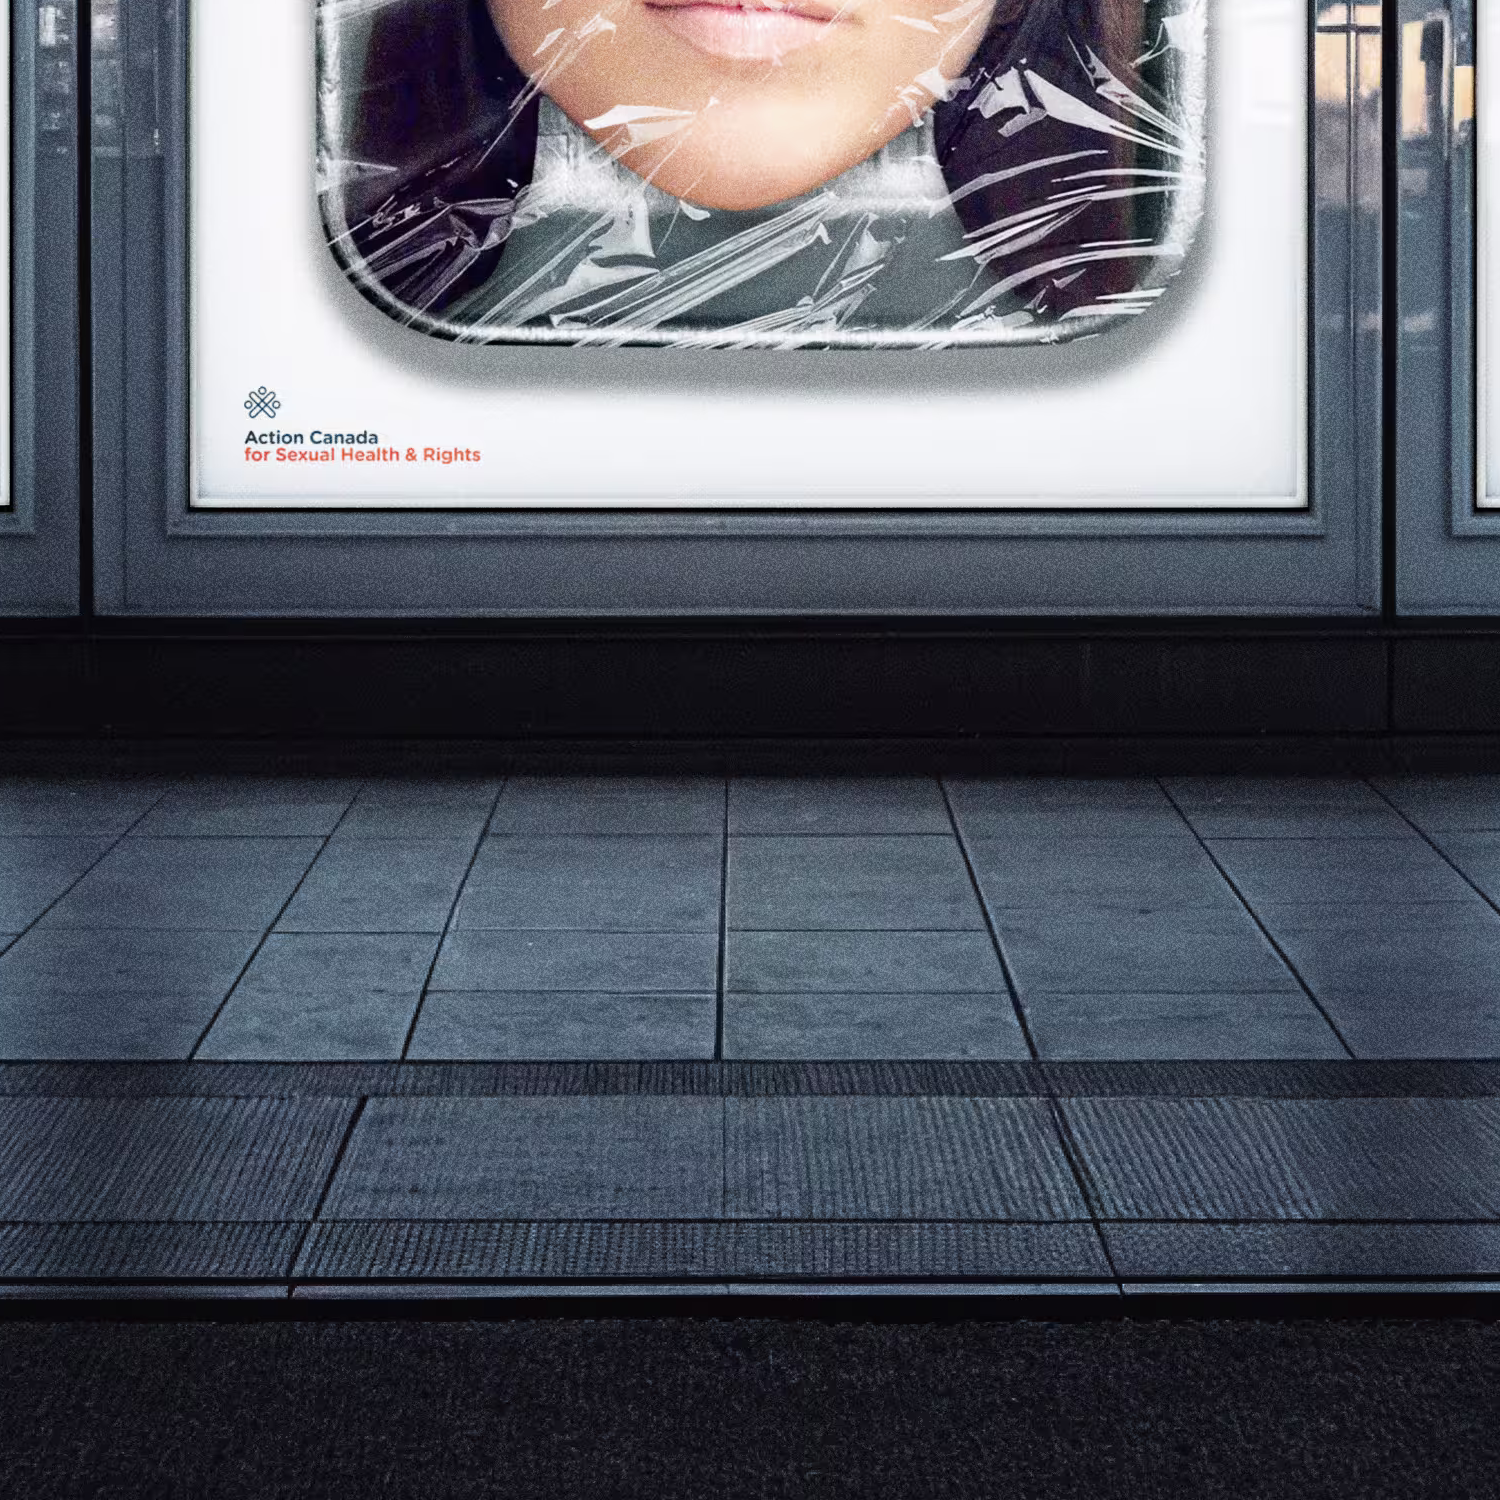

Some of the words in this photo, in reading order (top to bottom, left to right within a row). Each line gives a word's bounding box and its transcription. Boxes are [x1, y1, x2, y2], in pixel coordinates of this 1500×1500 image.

[245, 430, 304, 445] Action
[310, 430, 378, 445] Canada
[245, 447, 271, 462] for
[276, 447, 335, 462] Sexual
[341, 447, 400, 462] Health
[405, 447, 417, 462] &
[423, 447, 481, 464] Rights
